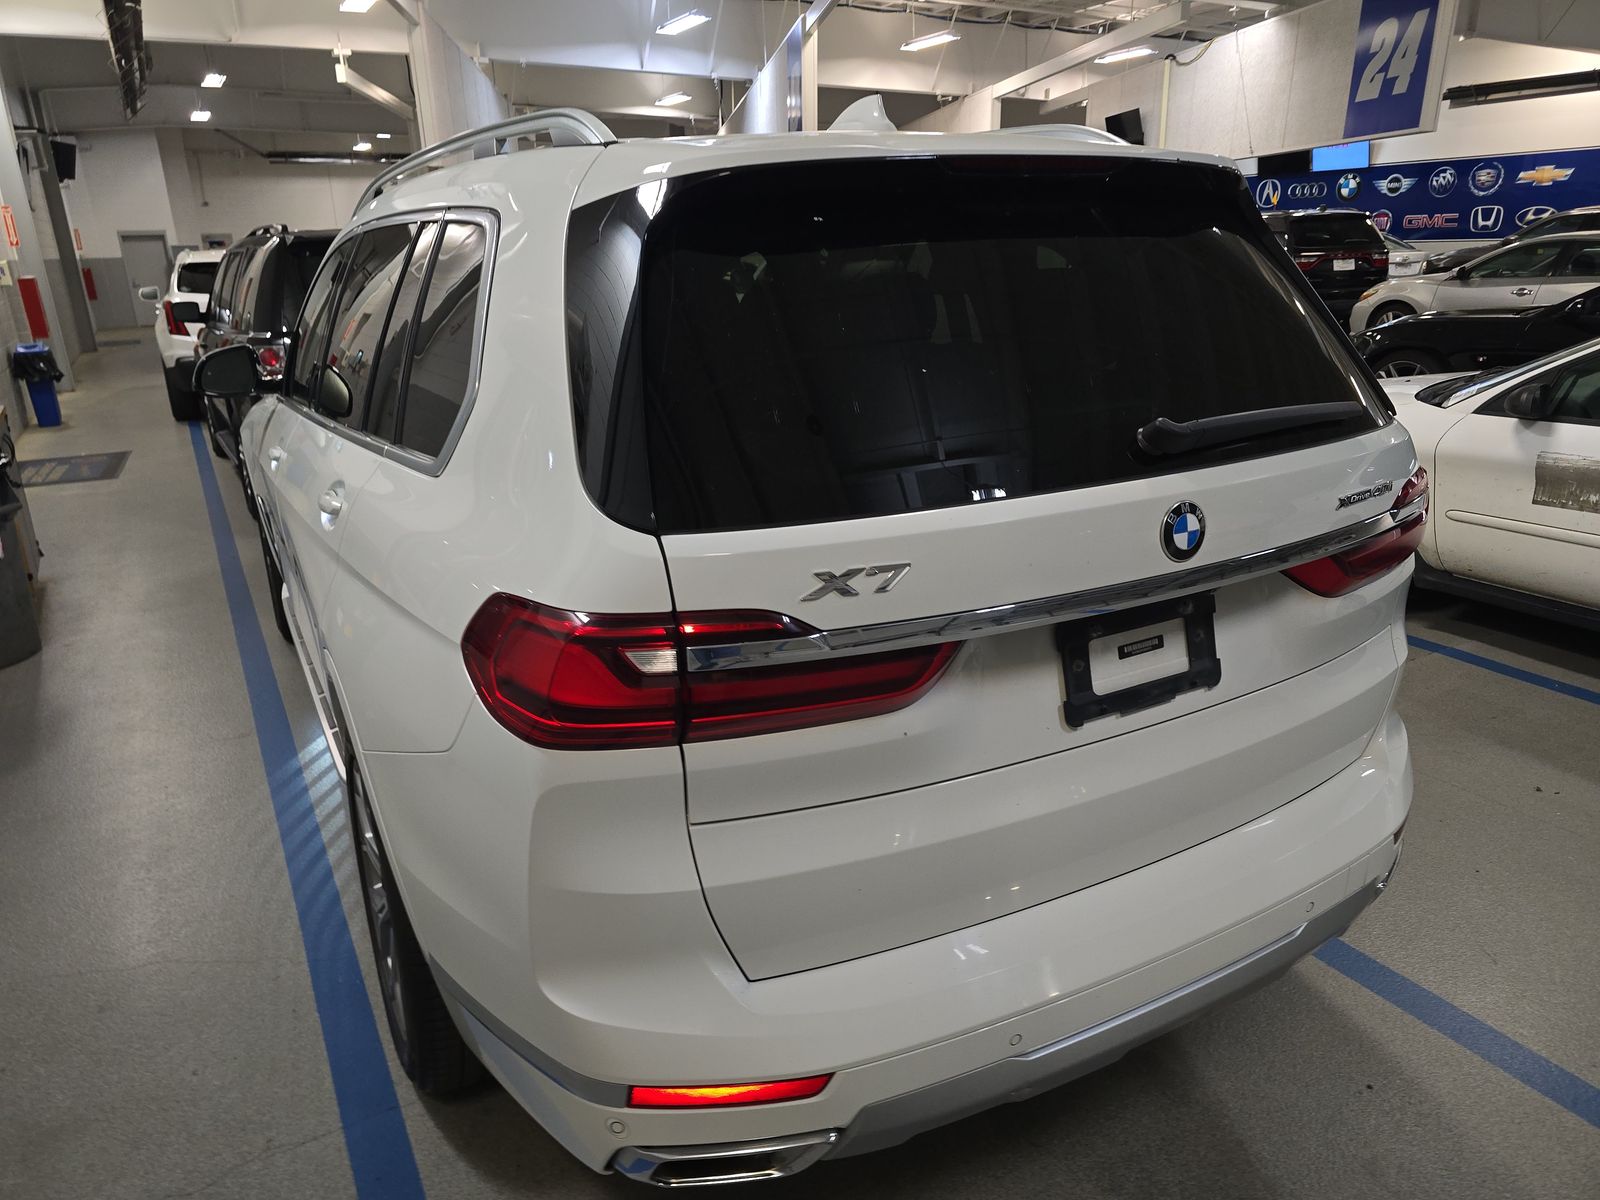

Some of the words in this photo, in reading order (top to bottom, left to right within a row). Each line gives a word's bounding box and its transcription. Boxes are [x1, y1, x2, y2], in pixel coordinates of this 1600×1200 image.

[1355, 8, 1431, 103] 24
[1403, 213, 1459, 229] GMC
[1168, 502, 1205, 525] BMW
[800, 562, 911, 602] X7
